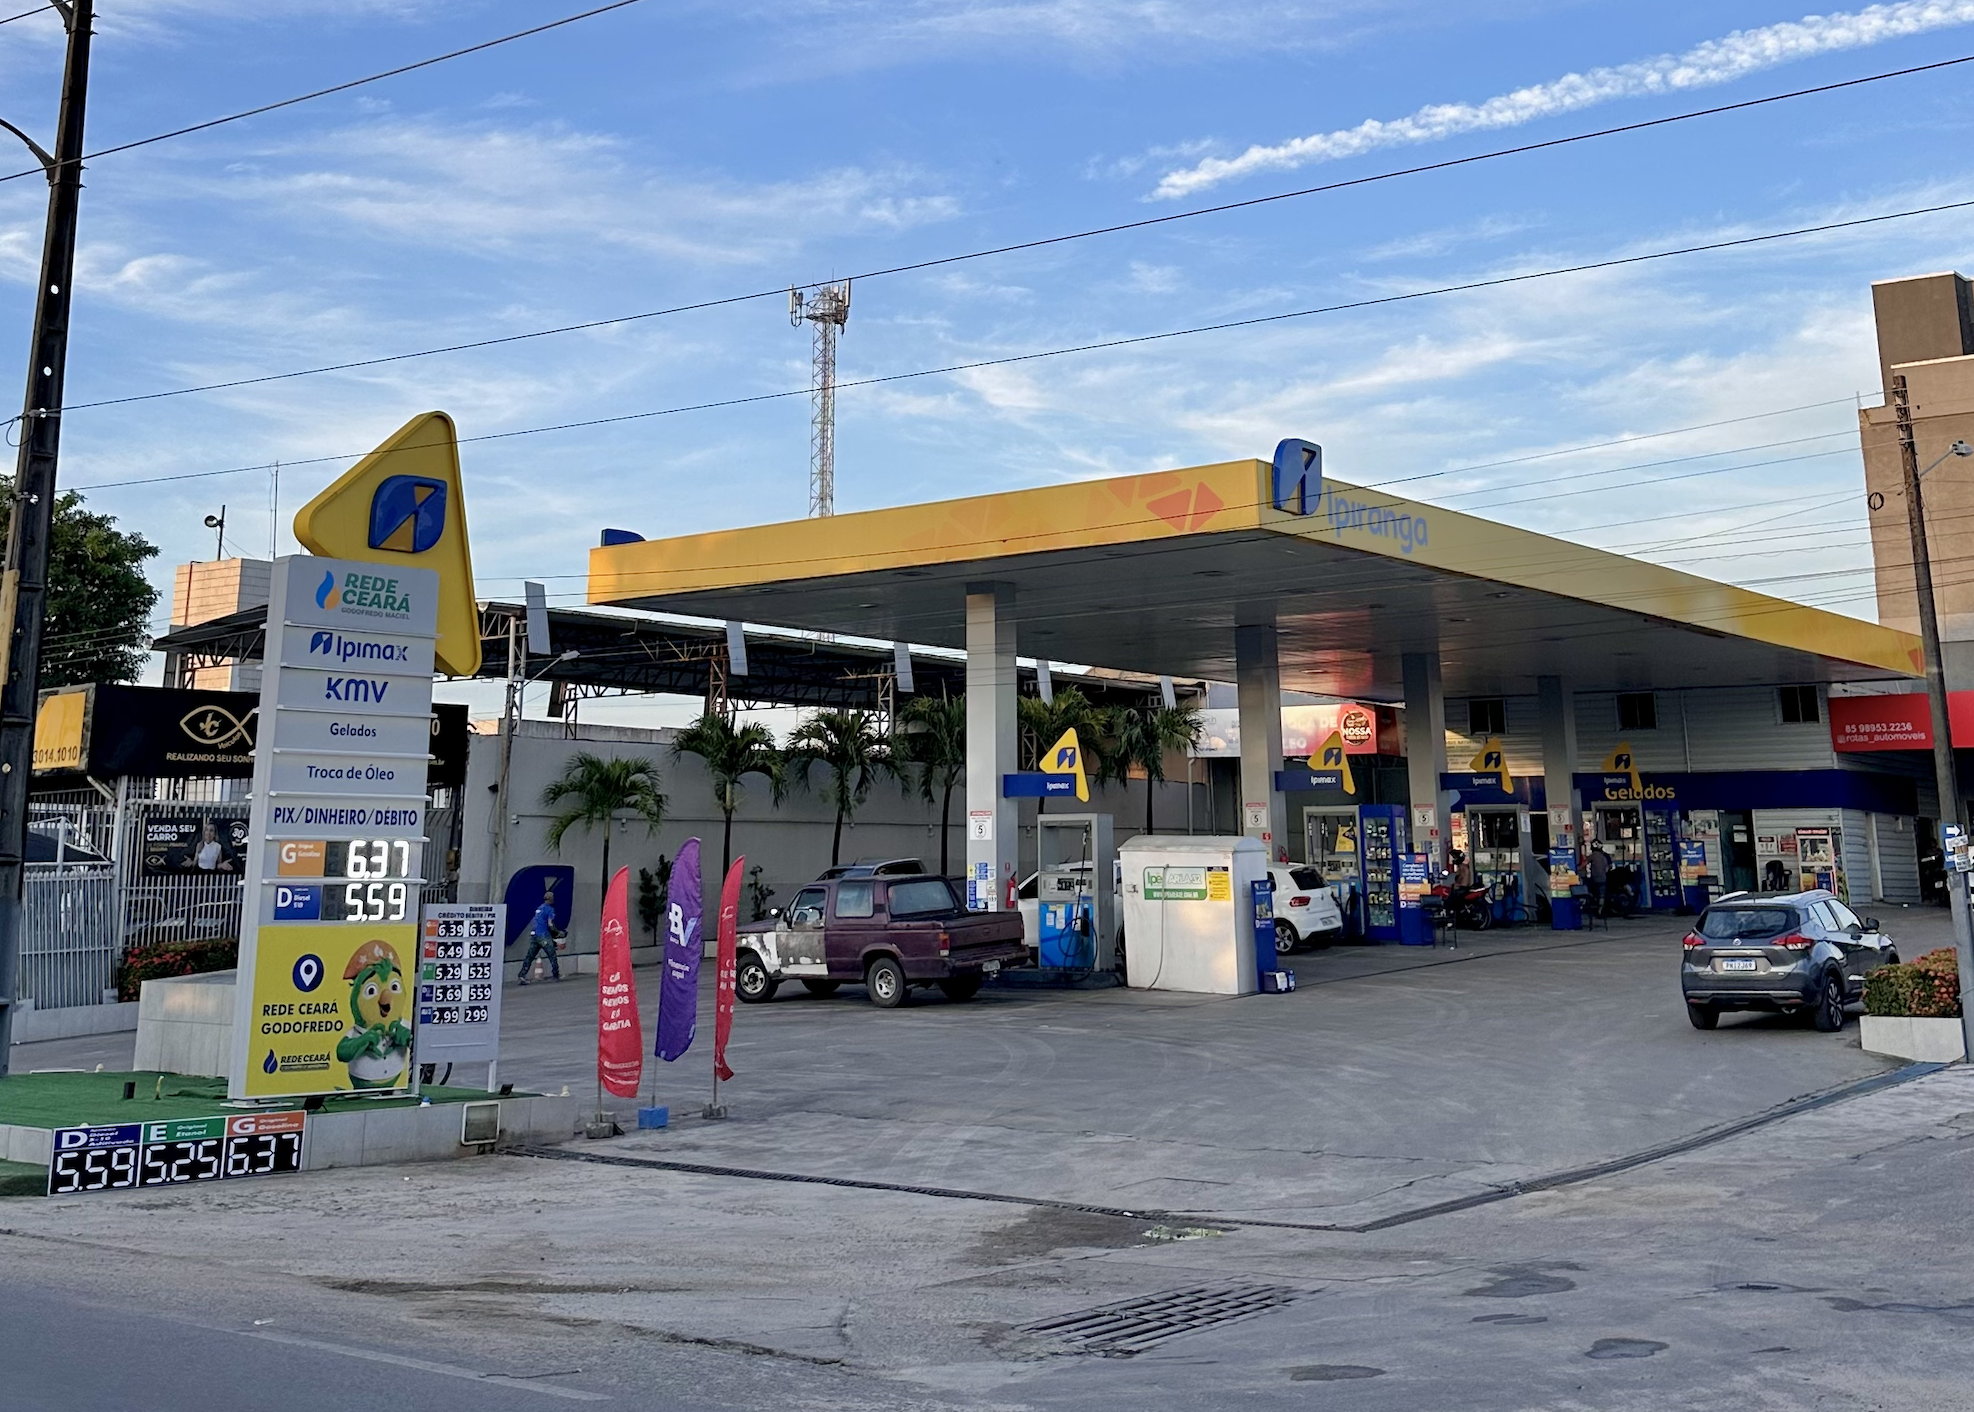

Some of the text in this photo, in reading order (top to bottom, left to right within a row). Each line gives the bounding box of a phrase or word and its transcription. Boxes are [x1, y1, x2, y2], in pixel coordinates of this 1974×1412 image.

[1327, 484, 1428, 554] Ipiranga
[345, 572, 398, 594] REDE
[342, 589, 410, 612] CEARÁ
[341, 607, 410, 620] GODOFREDO MACIEL
[336, 636, 409, 662] Ipimax
[325, 677, 389, 703] KMV
[330, 722, 377, 737] Gelados
[1342, 727, 1372, 735] NOSSA
[1845, 724, 1857, 733] 85
[166, 752, 215, 762] REALIZANDO
[216, 754, 232, 762] SEU
[307, 763, 394, 780] Troca de Óleo
[1311, 776, 1336, 786] Ipimax
[1254, 814, 1259, 823] 5
[147, 833, 178, 841] CARRO
[179, 825, 196, 833] SEU
[282, 843, 296, 864] G
[347, 840, 410, 879] 6,37
[277, 888, 292, 908] D
[345, 883, 407, 922] 5,59
[439, 924, 464, 938] 6,39
[437, 946, 463, 960] 6,49
[435, 967, 461, 982] 5,29
[436, 989, 461, 1003] 5,69
[263, 999, 339, 1017] REDE CEARÁ
[432, 1010, 459, 1024] 2,99
[261, 1020, 343, 1035] GODOFREDO
[150, 1124, 167, 1141] E
[175, 1129, 207, 1137] Etanol
[232, 1117, 256, 1134] G
[61, 1131, 88, 1148] D
[145, 1140, 218, 1184] 5.25
[227, 1133, 299, 1175] 6.37
[56, 1147, 135, 1192] 5.59
